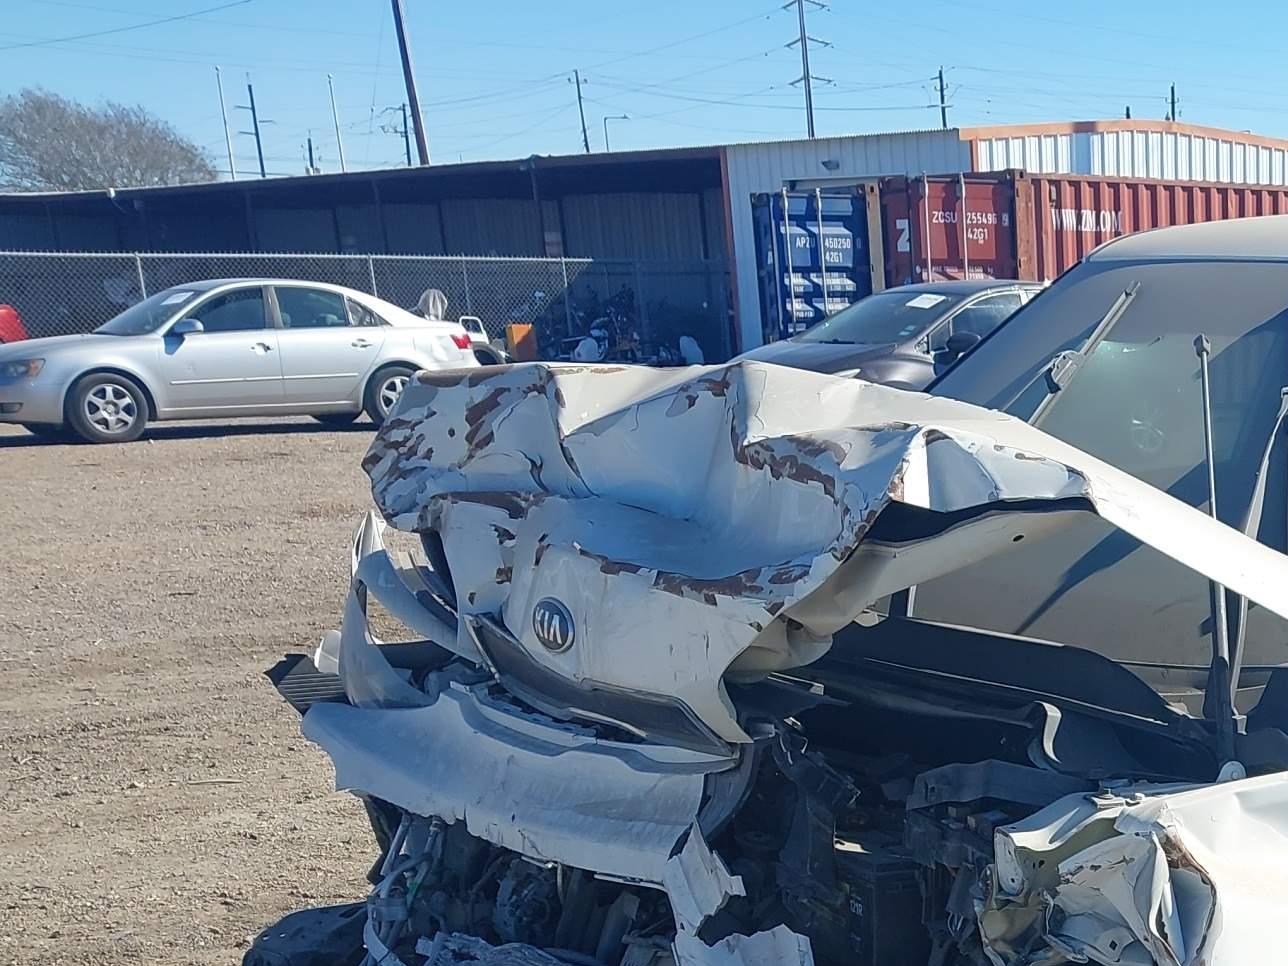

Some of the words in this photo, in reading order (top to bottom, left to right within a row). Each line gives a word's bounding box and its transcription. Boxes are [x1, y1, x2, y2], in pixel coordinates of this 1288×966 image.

[932, 211, 958, 223] ZCSU
[967, 228, 989, 240] 42G1
[825, 251, 843, 263] 42G1
[535, 606, 563, 645] KIA
